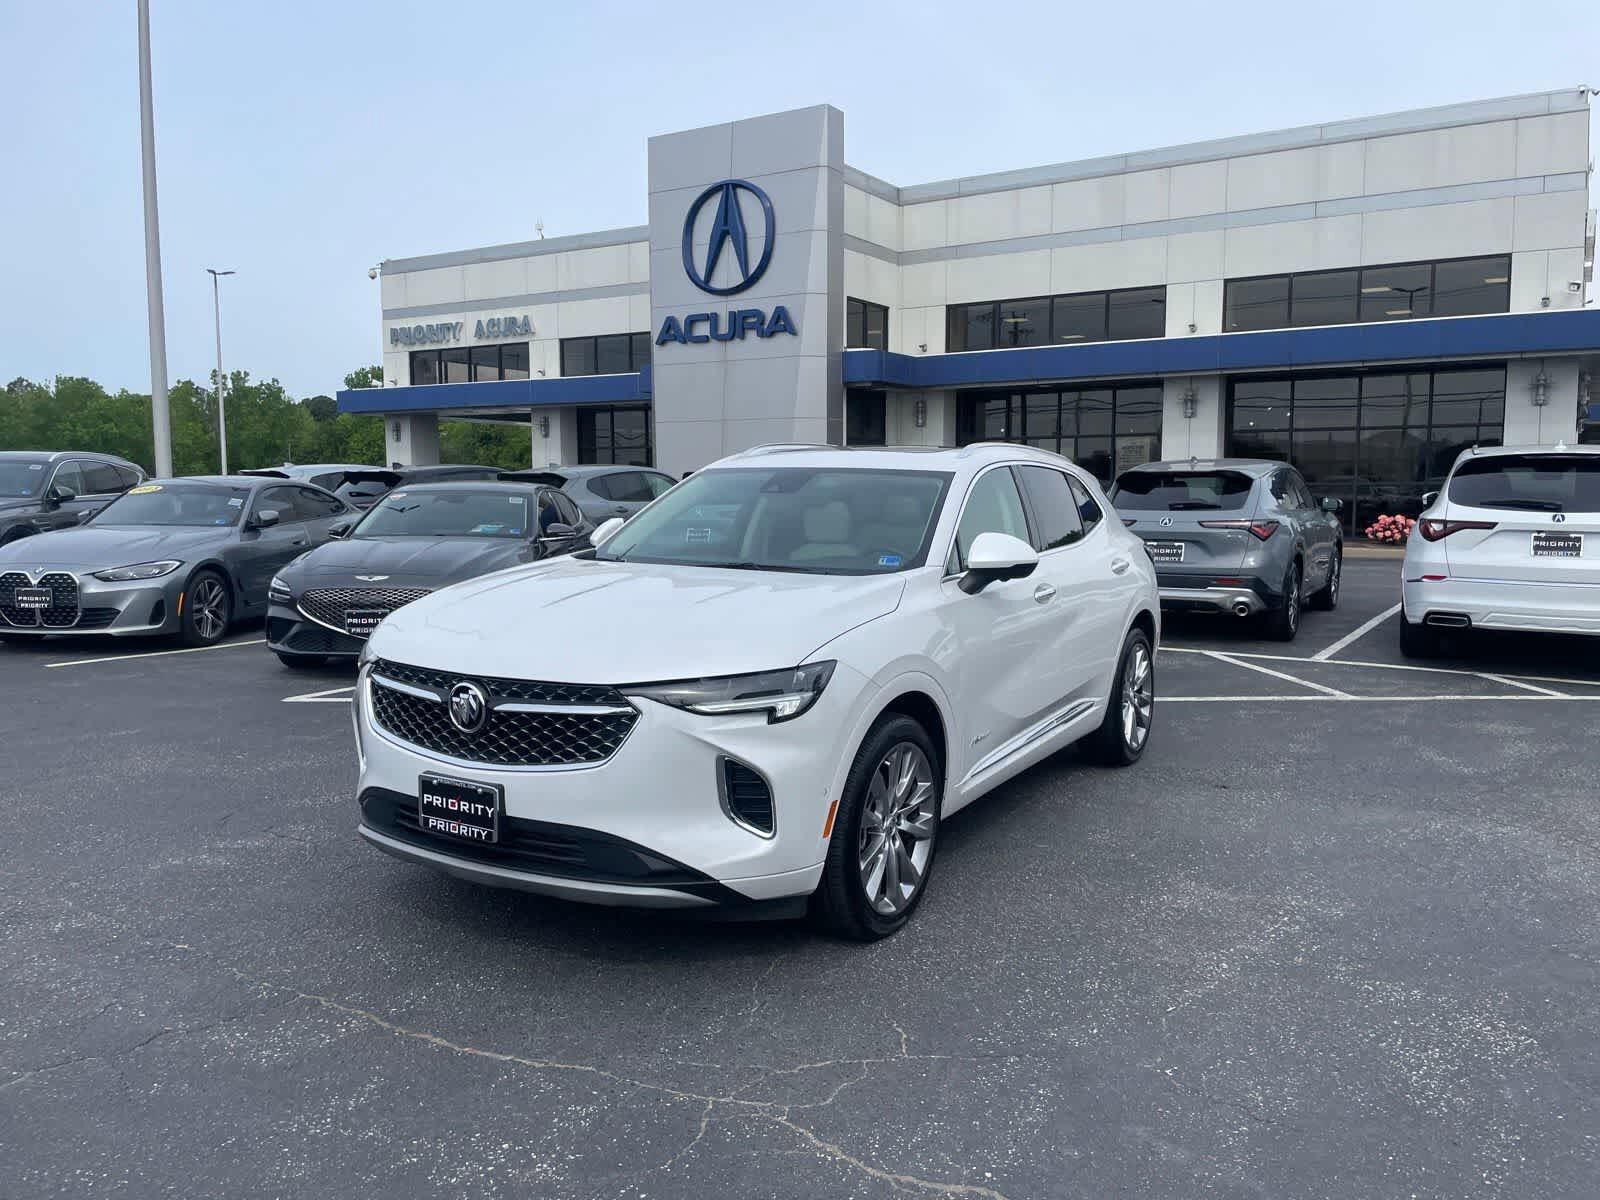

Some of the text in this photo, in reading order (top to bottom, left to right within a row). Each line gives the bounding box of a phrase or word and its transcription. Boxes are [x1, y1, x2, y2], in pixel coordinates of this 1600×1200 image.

[389, 314, 536, 346] PRIORITY ACURA
[656, 305, 798, 345] ACURA
[423, 793, 495, 818] PRIORITY
[428, 818, 488, 840] PRIORITY
